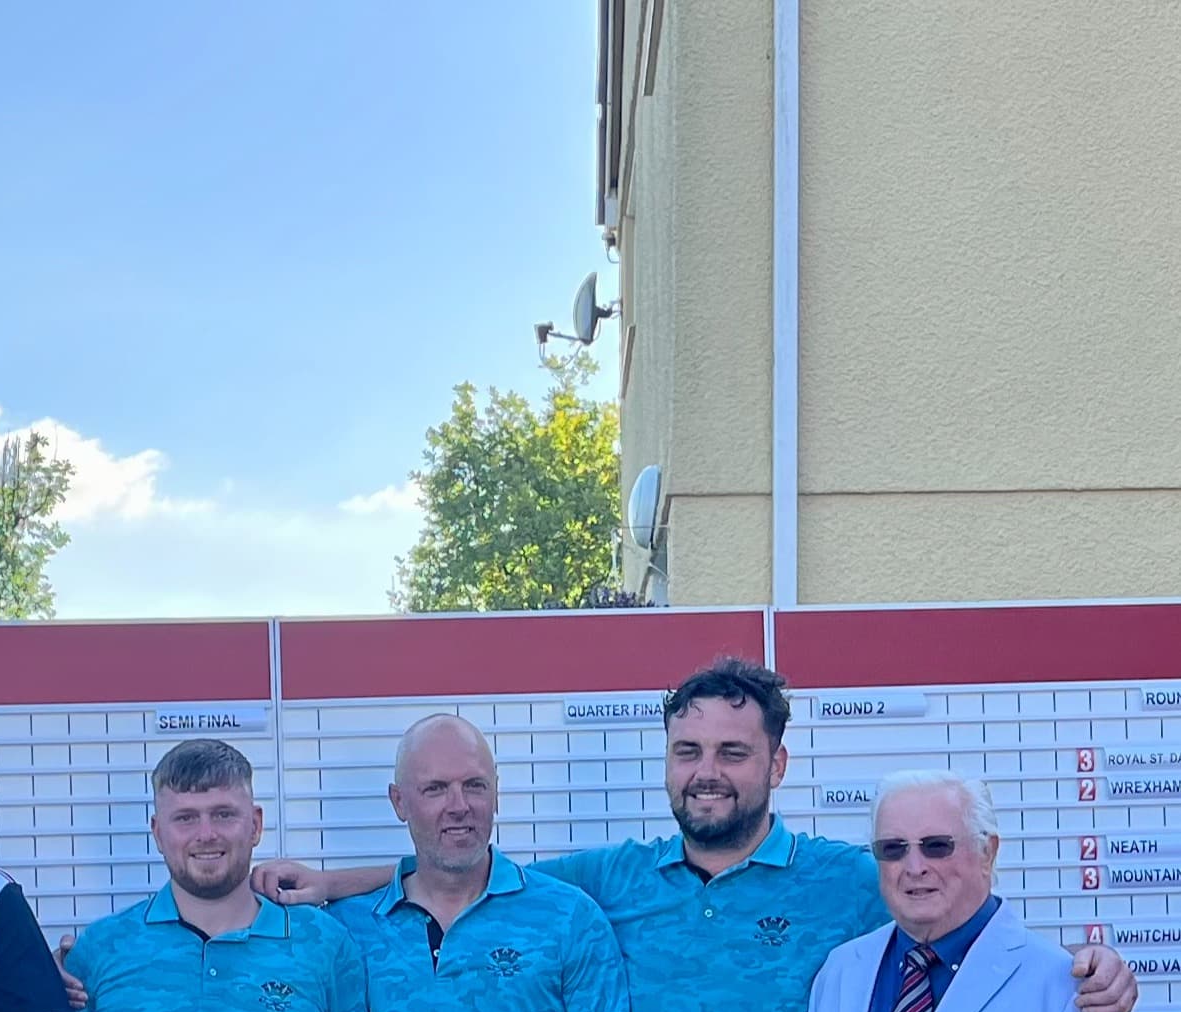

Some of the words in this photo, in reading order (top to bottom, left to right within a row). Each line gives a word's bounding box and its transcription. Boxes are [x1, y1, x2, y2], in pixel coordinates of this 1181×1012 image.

[567, 704, 629, 718] QUARTER
[633, 703, 663, 716] FINA
[822, 702, 873, 716] ROUND
[876, 702, 885, 714] 2
[159, 715, 194, 729] SEMI
[199, 714, 241, 728] FINAL
[1079, 749, 1093, 771] 3
[1108, 754, 1146, 765] ROYAL
[826, 790, 871, 803] ROYAL
[1080, 779, 1095, 800] 2
[1082, 837, 1096, 859] 2
[1110, 840, 1158, 854] NEATH
[1084, 867, 1098, 889] 3
[1089, 926, 1102, 944] 4
[1127, 960, 1158, 973] OND
